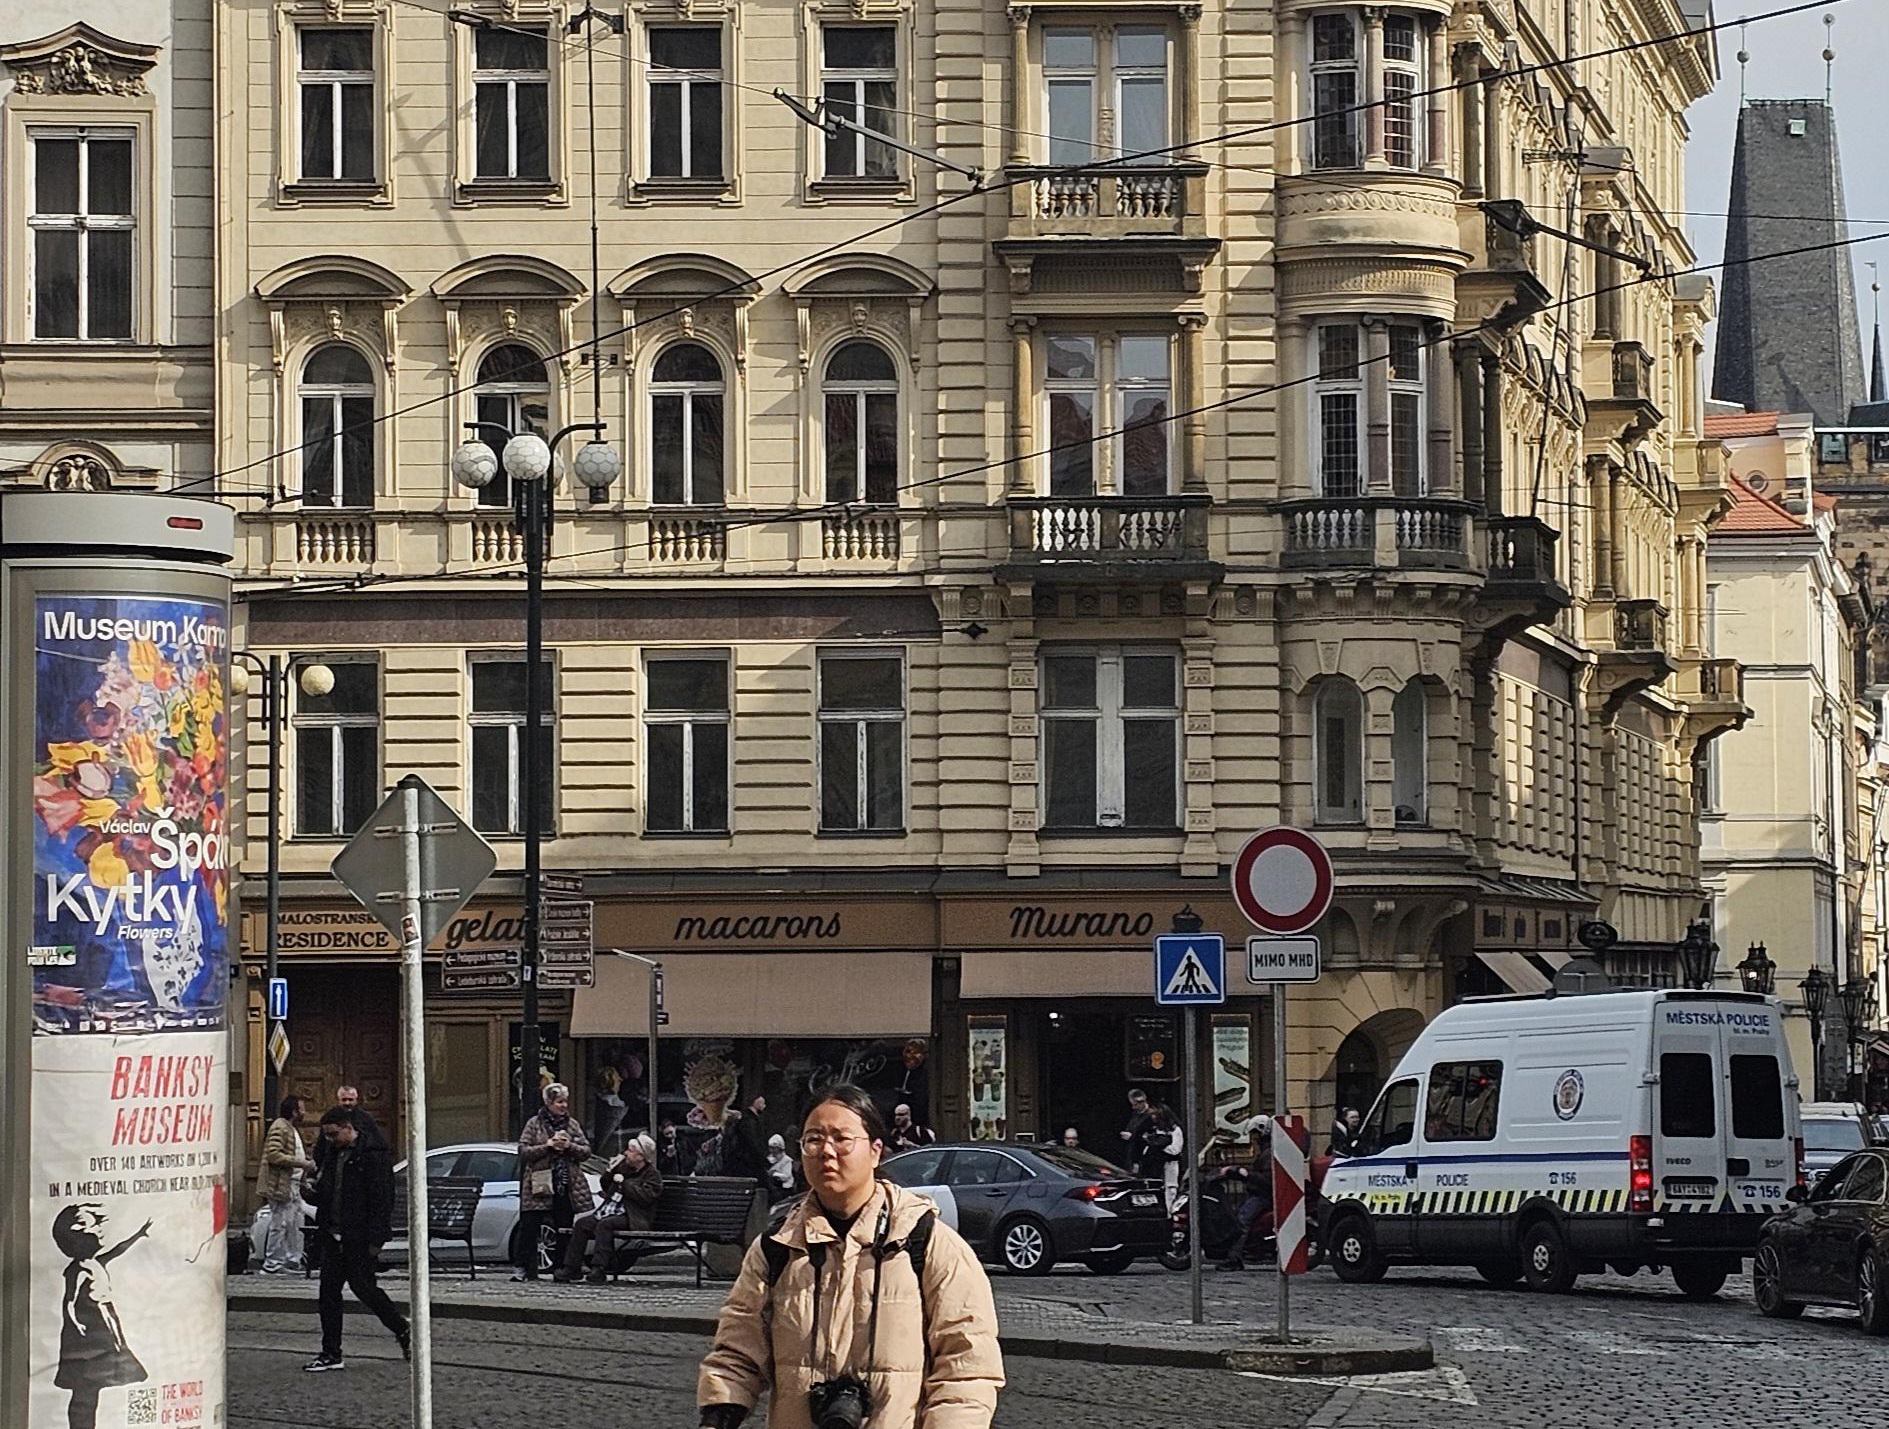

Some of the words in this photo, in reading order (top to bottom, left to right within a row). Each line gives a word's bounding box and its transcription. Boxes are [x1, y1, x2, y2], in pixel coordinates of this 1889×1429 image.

[44, 611, 176, 642] Museum
[183, 615, 226, 653] Kamp
[100, 820, 151, 834] Václav
[150, 807, 229, 881] Špál
[47, 870, 197, 935] Kytky
[277, 913, 378, 924] MALOSTRANSK
[673, 912, 841, 940] macarons
[1009, 906, 1153, 938] Murano
[117, 926, 174, 939] Flowers
[444, 911, 526, 949] gelat
[1255, 953, 1285, 967] MIMO
[1288, 953, 1313, 967] MHD
[1726, 1013, 1770, 1026] POLICIE
[111, 1055, 213, 1100] BANKSY
[112, 1104, 213, 1146] MUSEUM
[90, 1156, 116, 1172] OVER
[1436, 1174, 1469, 1187] POLICIE
[1561, 1172, 1577, 1185] 156
[49, 1182, 60, 1197] IN
[65, 1182, 72, 1196] A
[77, 1180, 129, 1196] MEDIEVAL
[1760, 1185, 1781, 1198] 156
[162, 1384, 177, 1400] THE
[161, 1409, 172, 1424] OF
